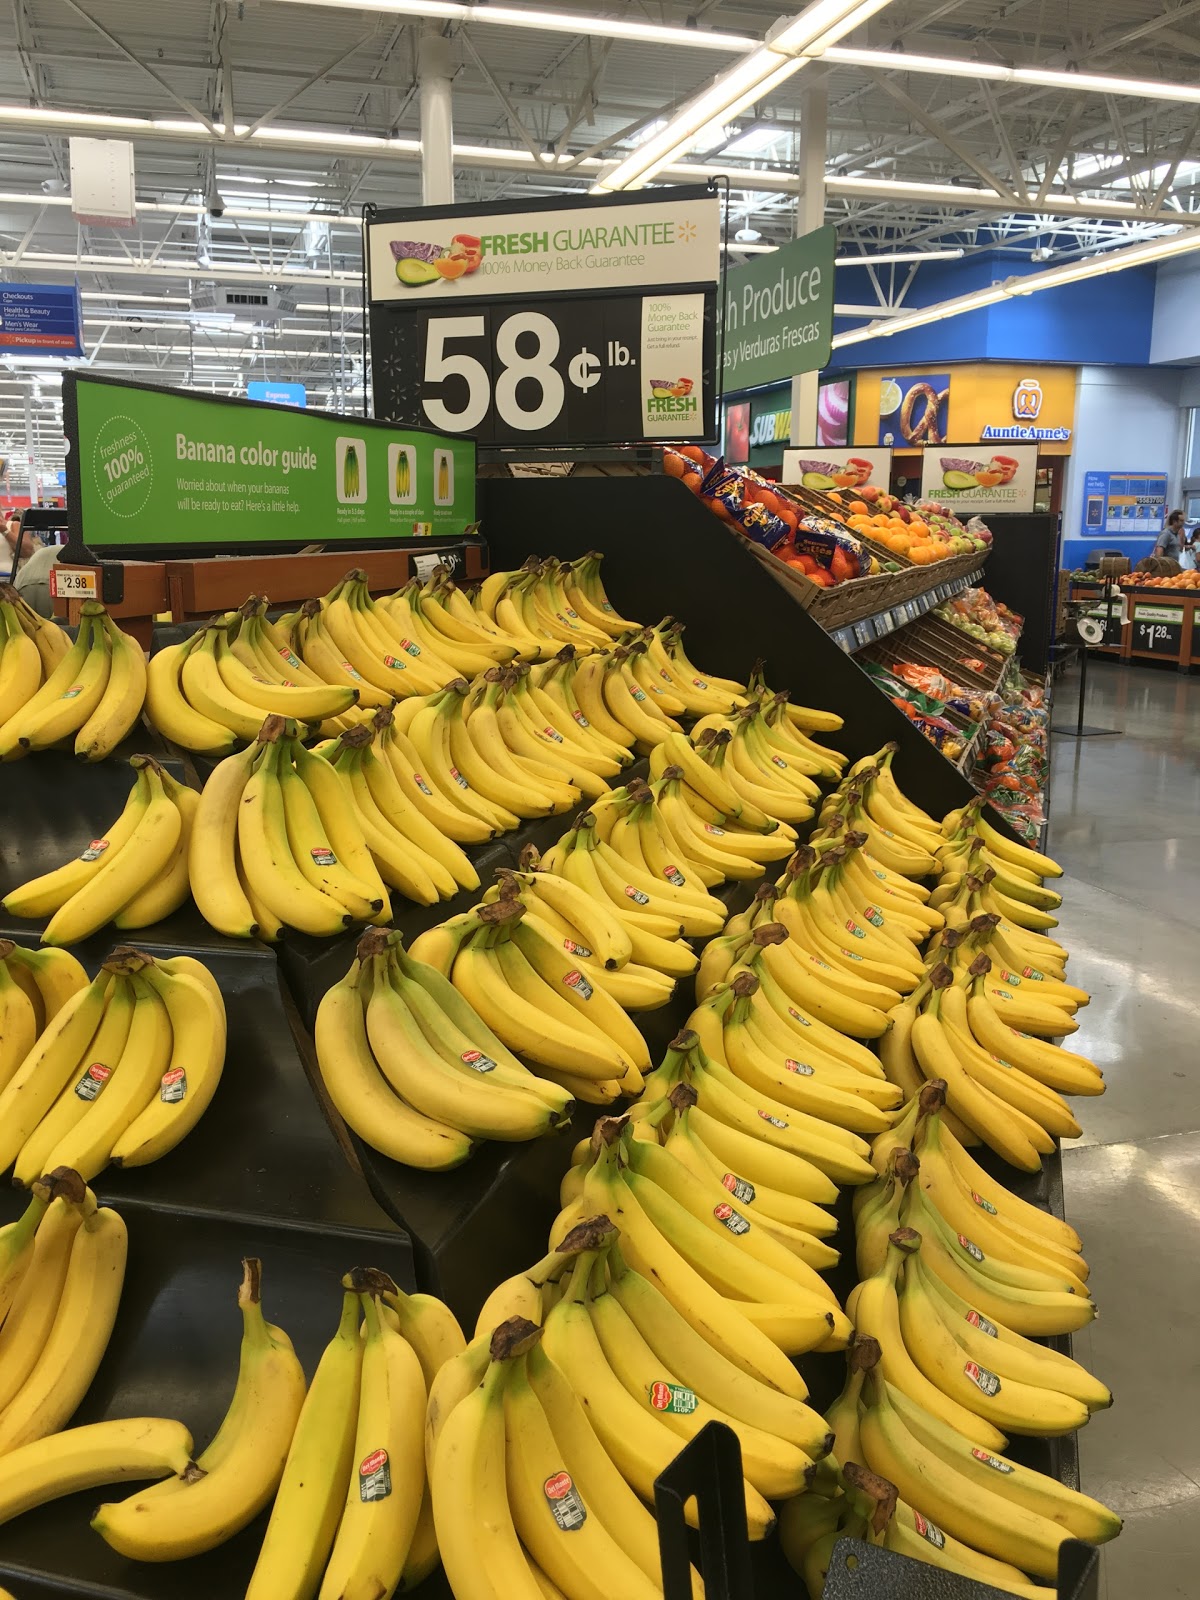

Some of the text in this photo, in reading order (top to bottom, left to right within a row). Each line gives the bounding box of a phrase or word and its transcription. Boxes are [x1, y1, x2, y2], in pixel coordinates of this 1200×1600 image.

[481, 222, 675, 256] FRESH GUARANTEE
[481, 253, 646, 276] 100% Money Back Guarantee
[2, 292, 34, 300] Checkouts
[742, 265, 822, 326] Produce
[29, 308, 51, 316] Beauty
[648, 303, 672, 312] 100%
[647, 310, 699, 324] Money Back
[647, 322, 691, 333] Guarantee
[15, 336, 37, 344] Pickup
[739, 333, 781, 364] Verduras
[782, 320, 820, 347] Frescas
[607, 340, 637, 367] lb.
[647, 397, 697, 413] FRESH
[647, 413, 690, 422] GUARANTEE
[983, 425, 1071, 440] Auntie Anne's
[99, 431, 137, 460] freshness
[175, 433, 318, 475] Banana color guide
[103, 445, 145, 483] 100%
[106, 464, 151, 504] guaranteed
[176, 478, 290, 497] Worried about when your bananas
[928, 488, 1018, 499] FRESH GUARANTEE
[177, 499, 301, 515] will be ready to eat? Here's a little help.
[64, 576, 88, 589] $2.98
